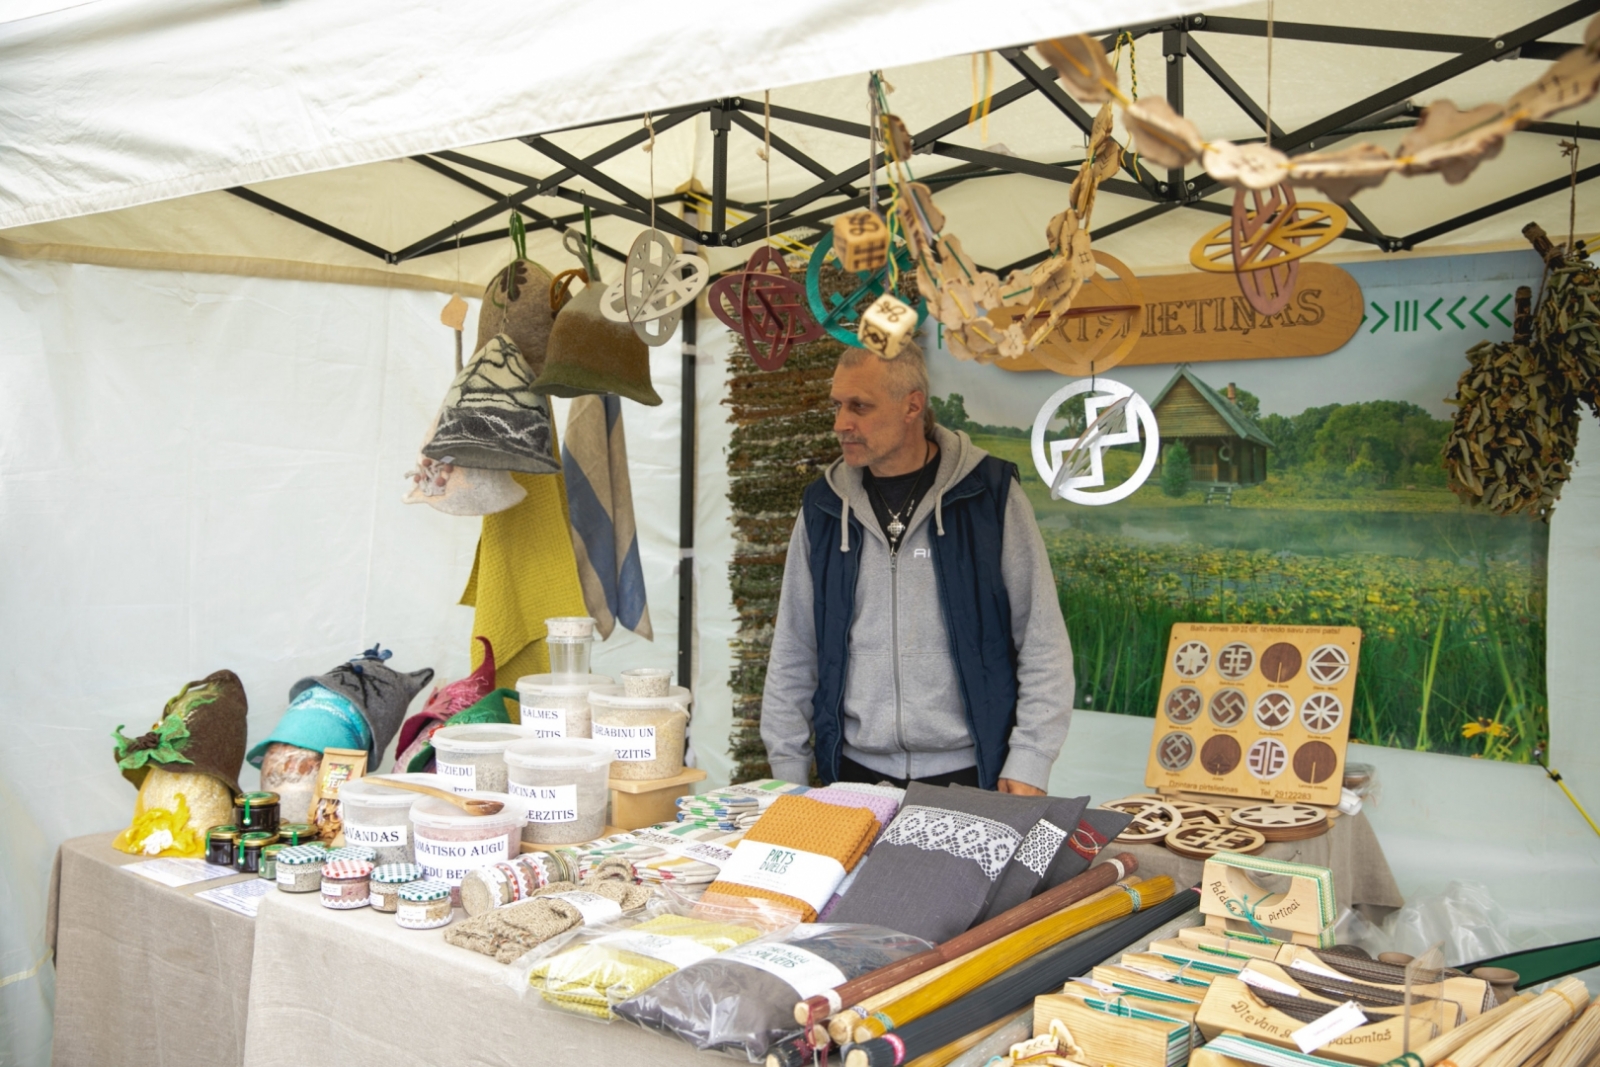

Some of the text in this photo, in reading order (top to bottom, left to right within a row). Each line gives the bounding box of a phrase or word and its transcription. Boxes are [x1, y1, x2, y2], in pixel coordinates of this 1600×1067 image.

[639, 727, 654, 738] UN
[540, 789, 556, 799] UN
[343, 826, 400, 842] AVANDAS
[470, 840, 505, 857] AUGU
[766, 848, 797, 865] PIRTS
[1230, 999, 1279, 1035] Dievam
